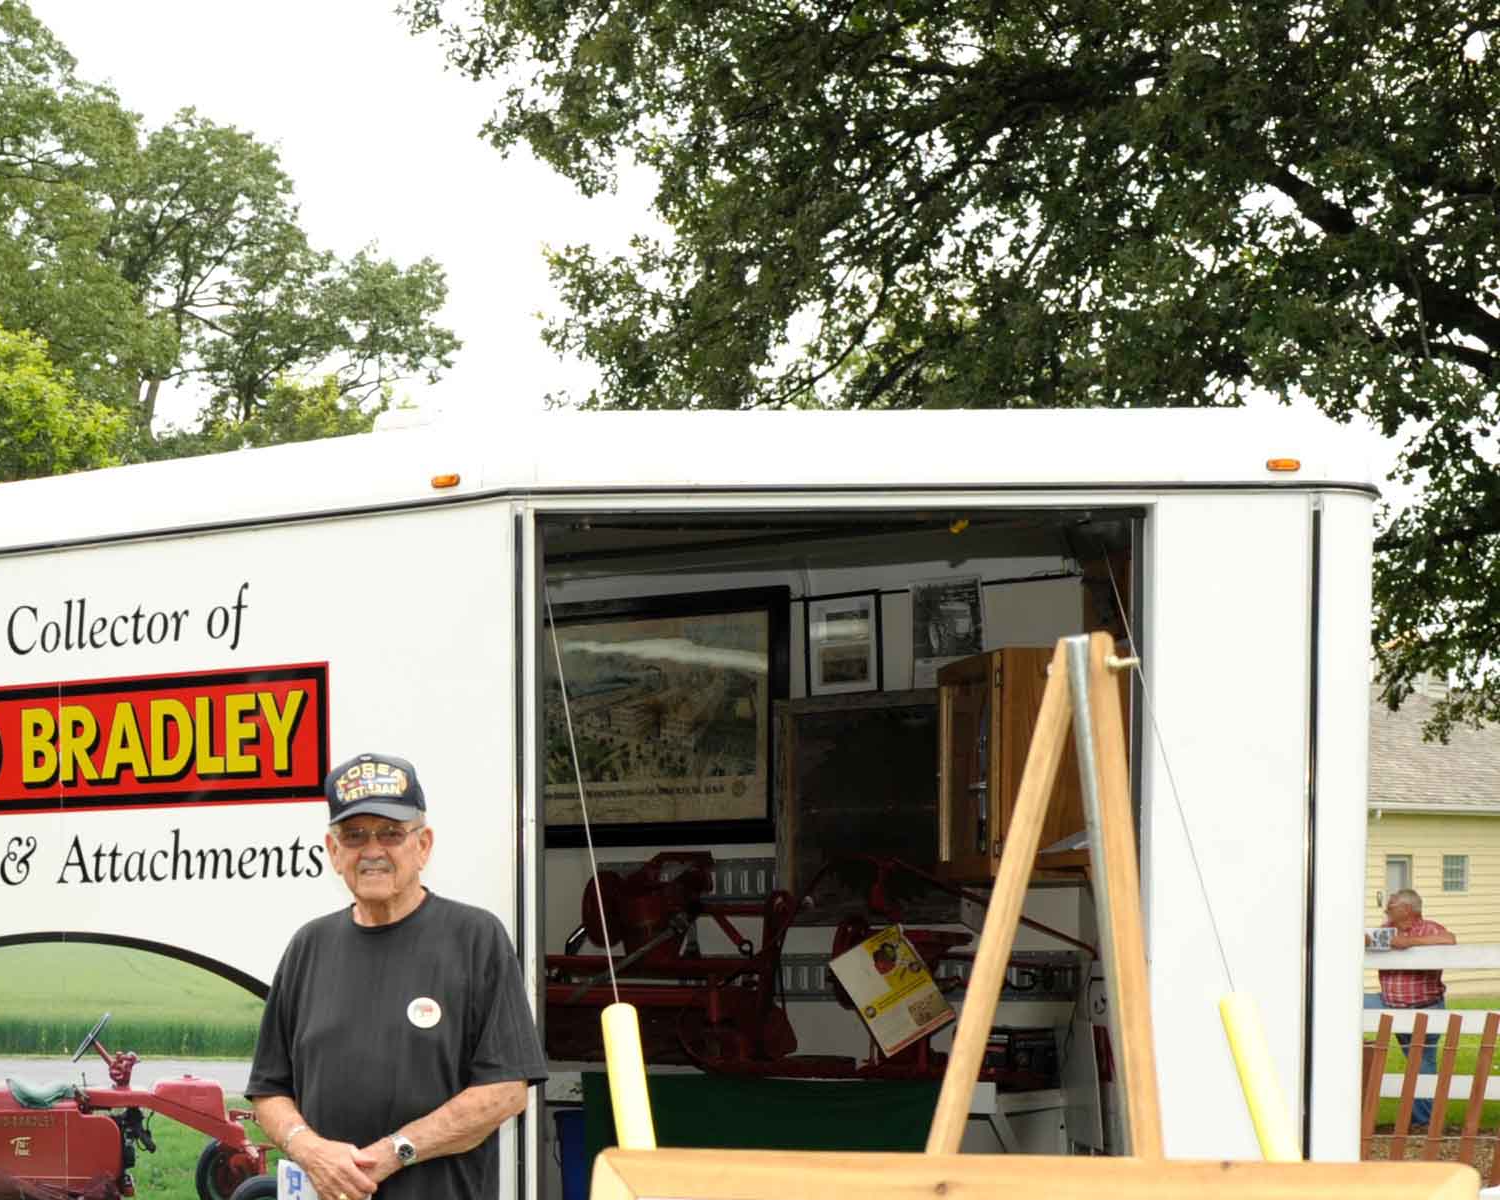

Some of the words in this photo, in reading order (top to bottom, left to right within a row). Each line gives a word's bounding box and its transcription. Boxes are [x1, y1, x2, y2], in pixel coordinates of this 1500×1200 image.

[7, 598, 189, 655] Collector
[206, 582, 250, 650] of
[21, 689, 307, 787] BRADLEY
[0, 835, 38, 886] &
[56, 829, 325, 885] Attachments
